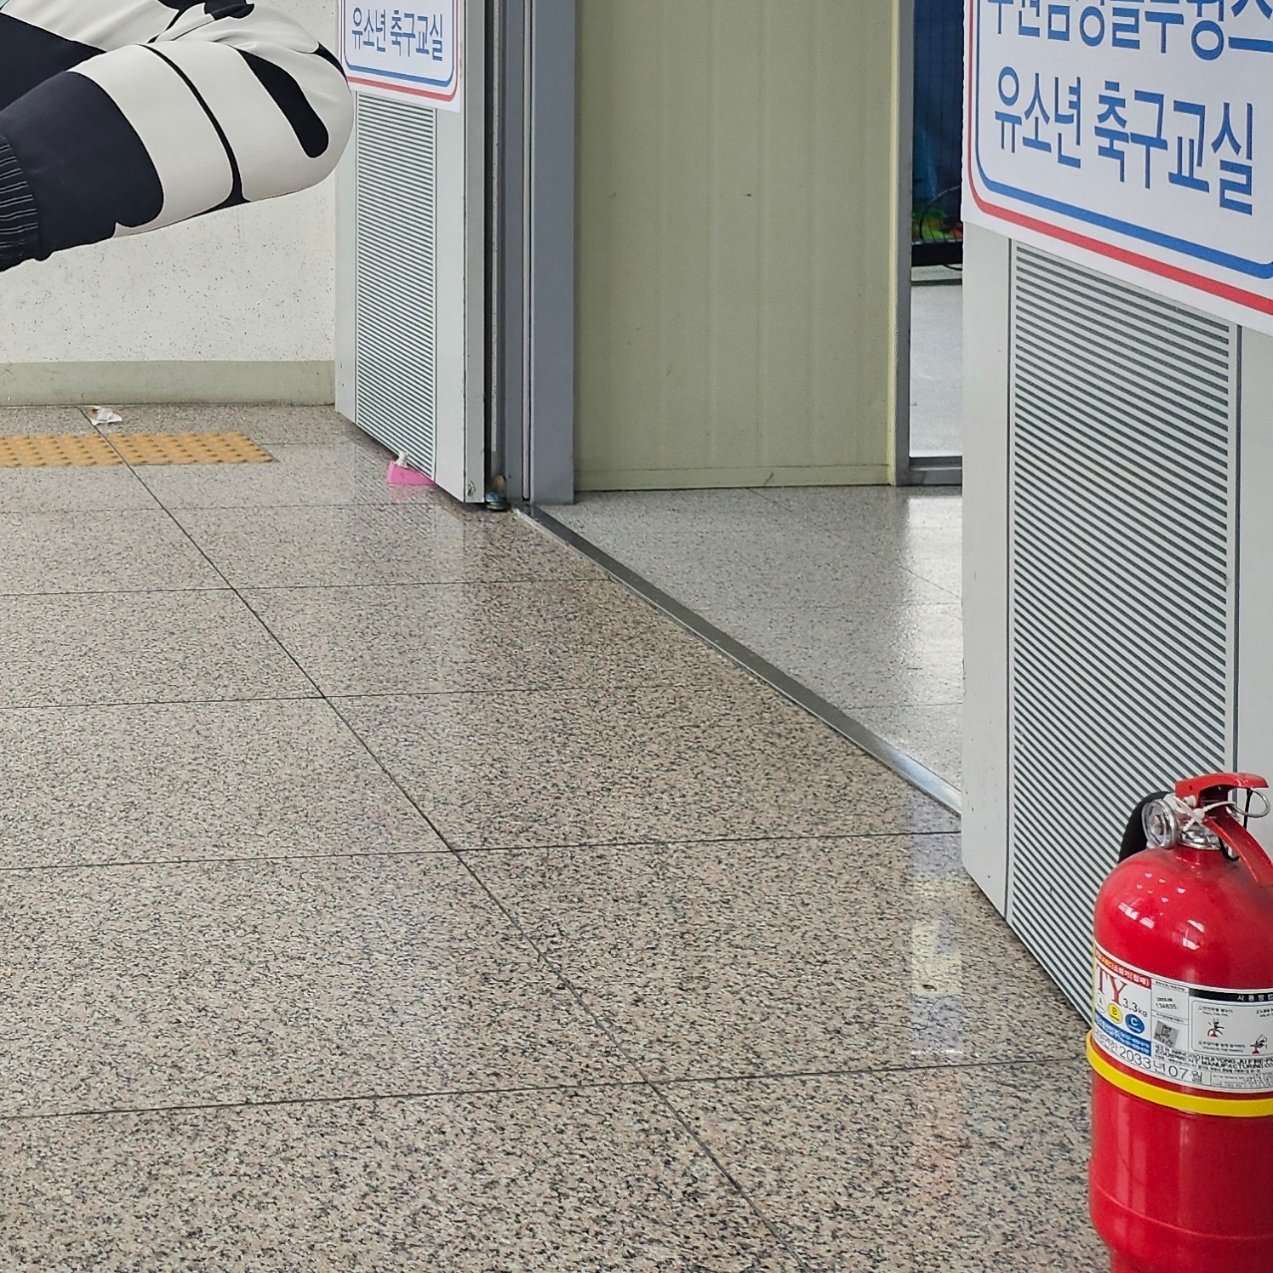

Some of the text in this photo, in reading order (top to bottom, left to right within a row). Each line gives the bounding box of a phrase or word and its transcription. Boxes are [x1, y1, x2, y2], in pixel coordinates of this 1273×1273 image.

[352, 7, 443, 61] 유소년 축구교실
[995, 66, 1253, 216] 유소년 축구교실
[1130, 1018, 1138, 1026] C
